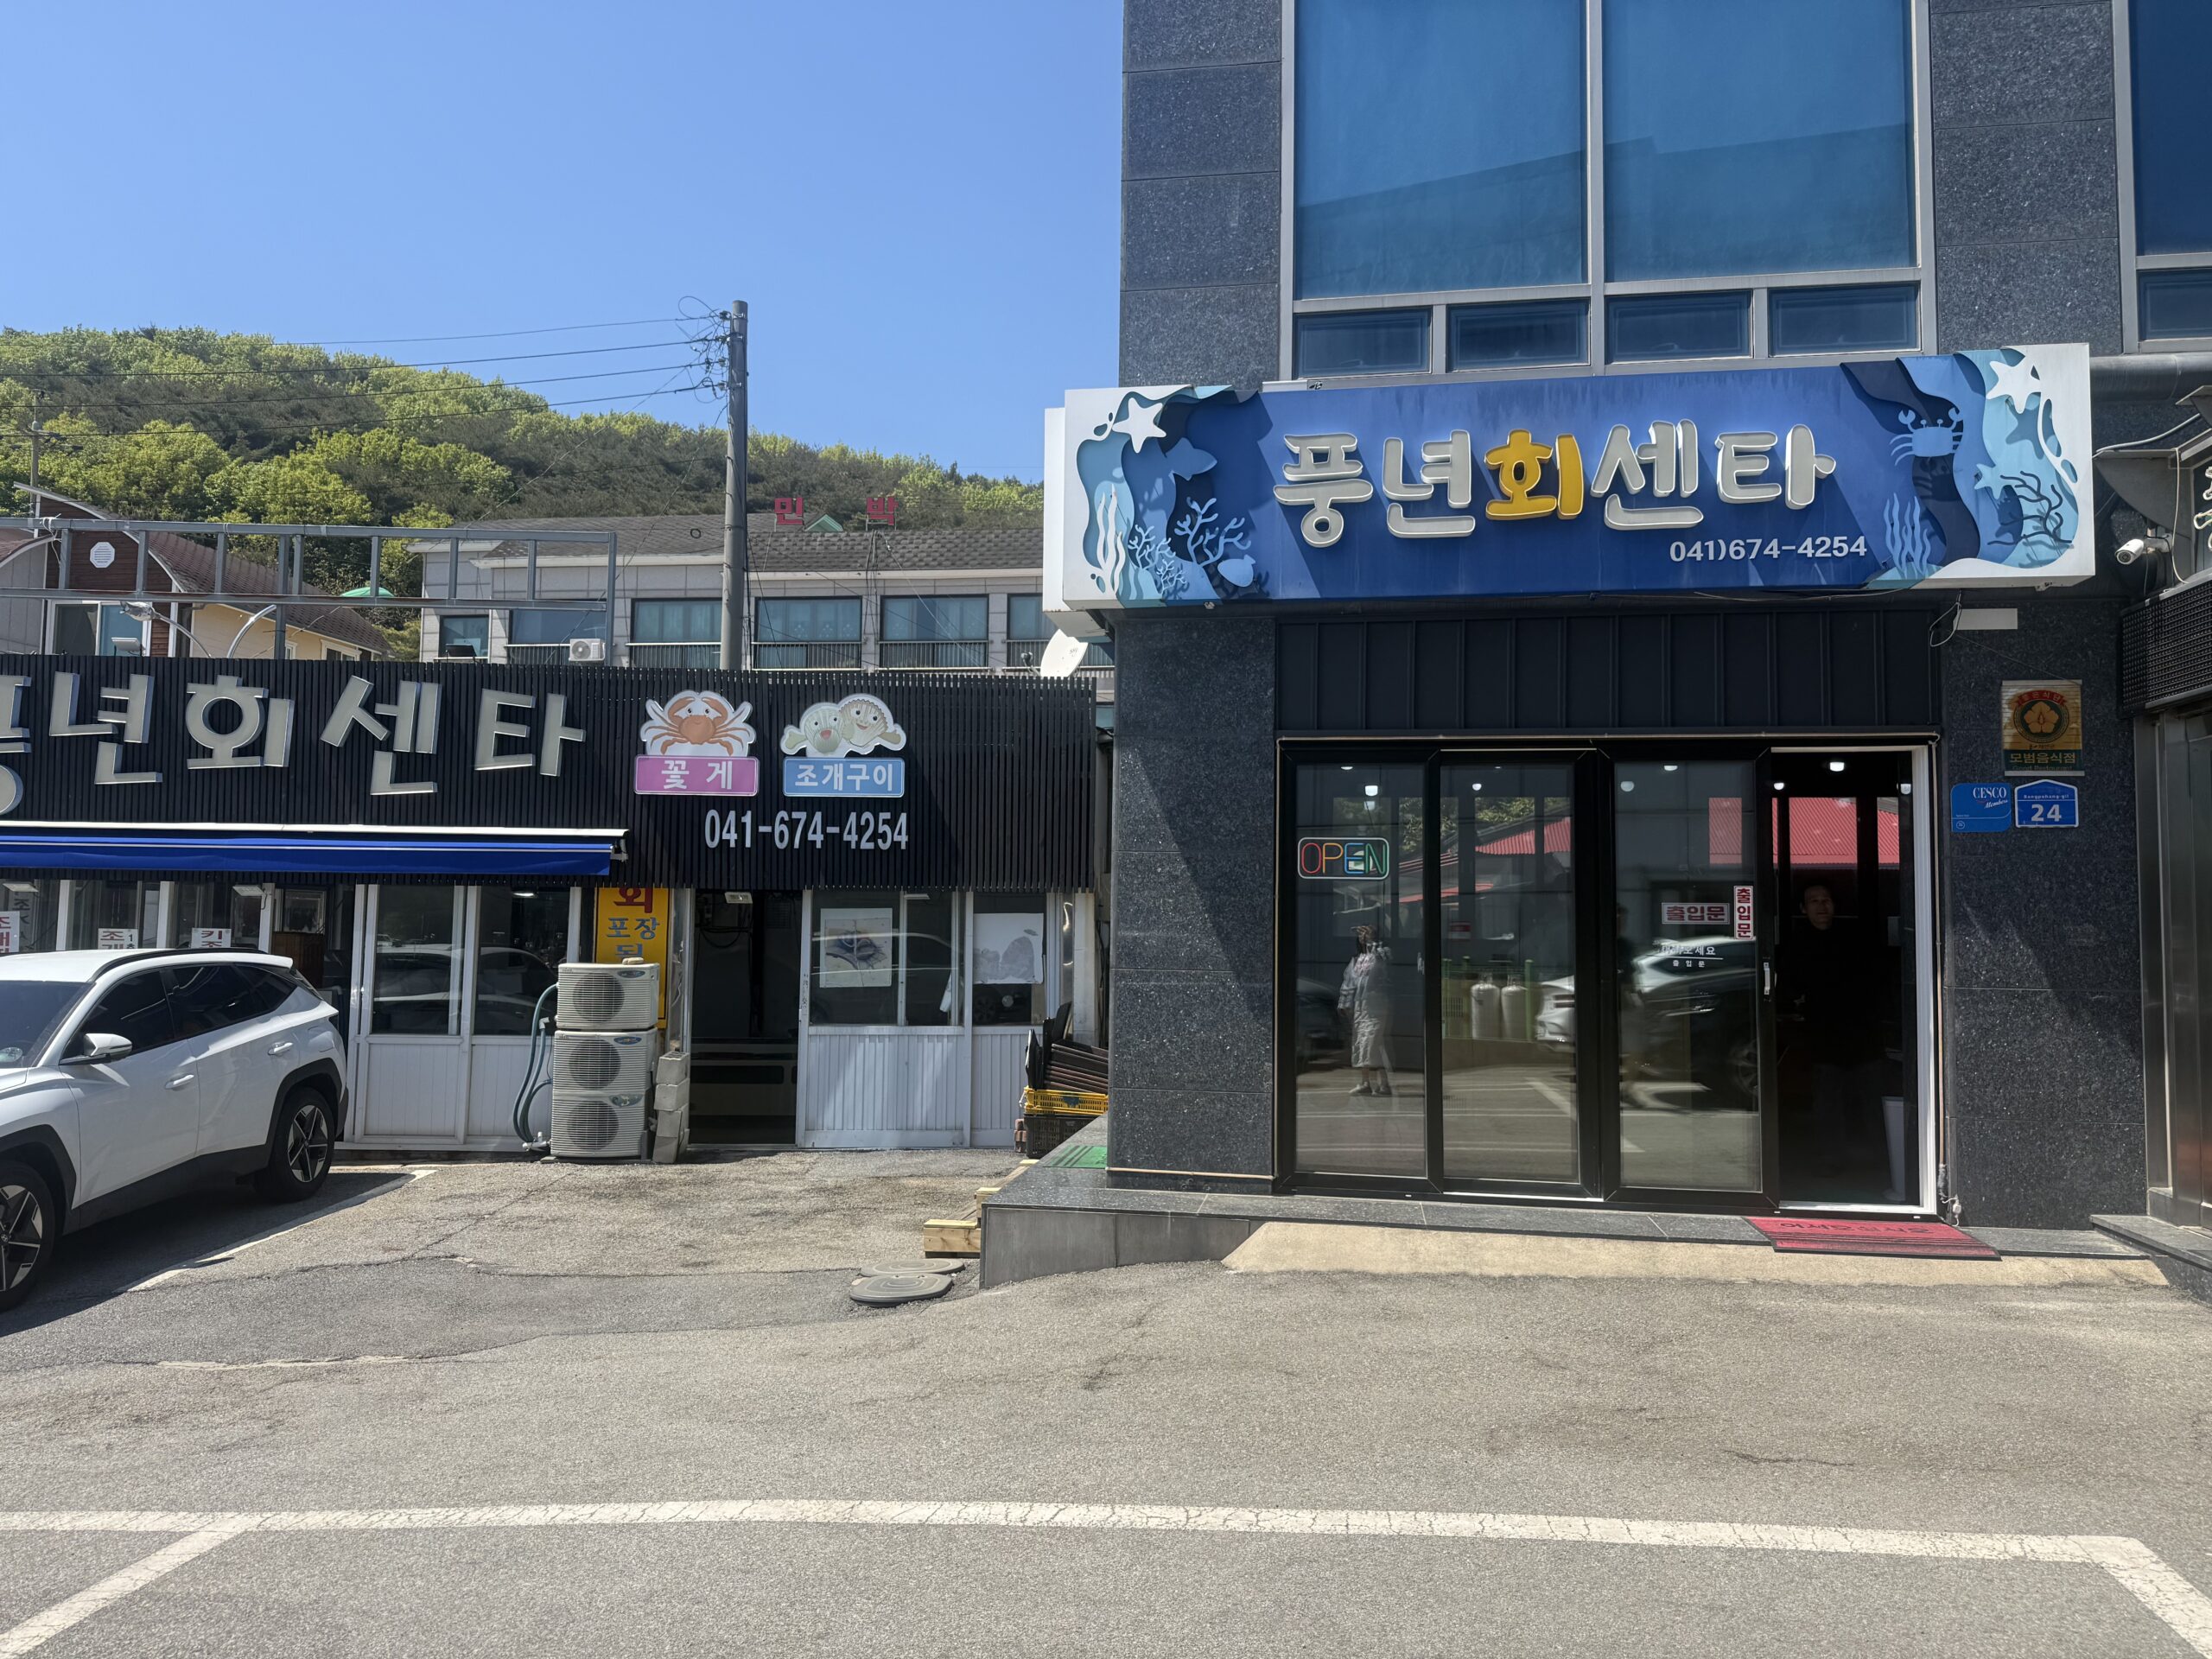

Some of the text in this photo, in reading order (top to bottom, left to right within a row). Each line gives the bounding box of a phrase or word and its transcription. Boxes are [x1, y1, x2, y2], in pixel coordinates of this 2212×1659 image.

[1273, 418, 1837, 549] 풍년회센타
[1669, 536, 1867, 563] 041)674-4254
[2009, 753, 2075, 764] 모범음식점
[661, 760, 733, 791] 꽃게
[795, 763, 893, 792] 조개구이
[1973, 787, 2007, 798] CESCO
[2031, 804, 2063, 822] 24
[704, 810, 909, 850] 041-674-4254
[1300, 842, 1387, 874] OPEN
[1666, 906, 1726, 921] 출입문
[1737, 888, 1751, 938] 출입문
[607, 918, 660, 939] 포장
